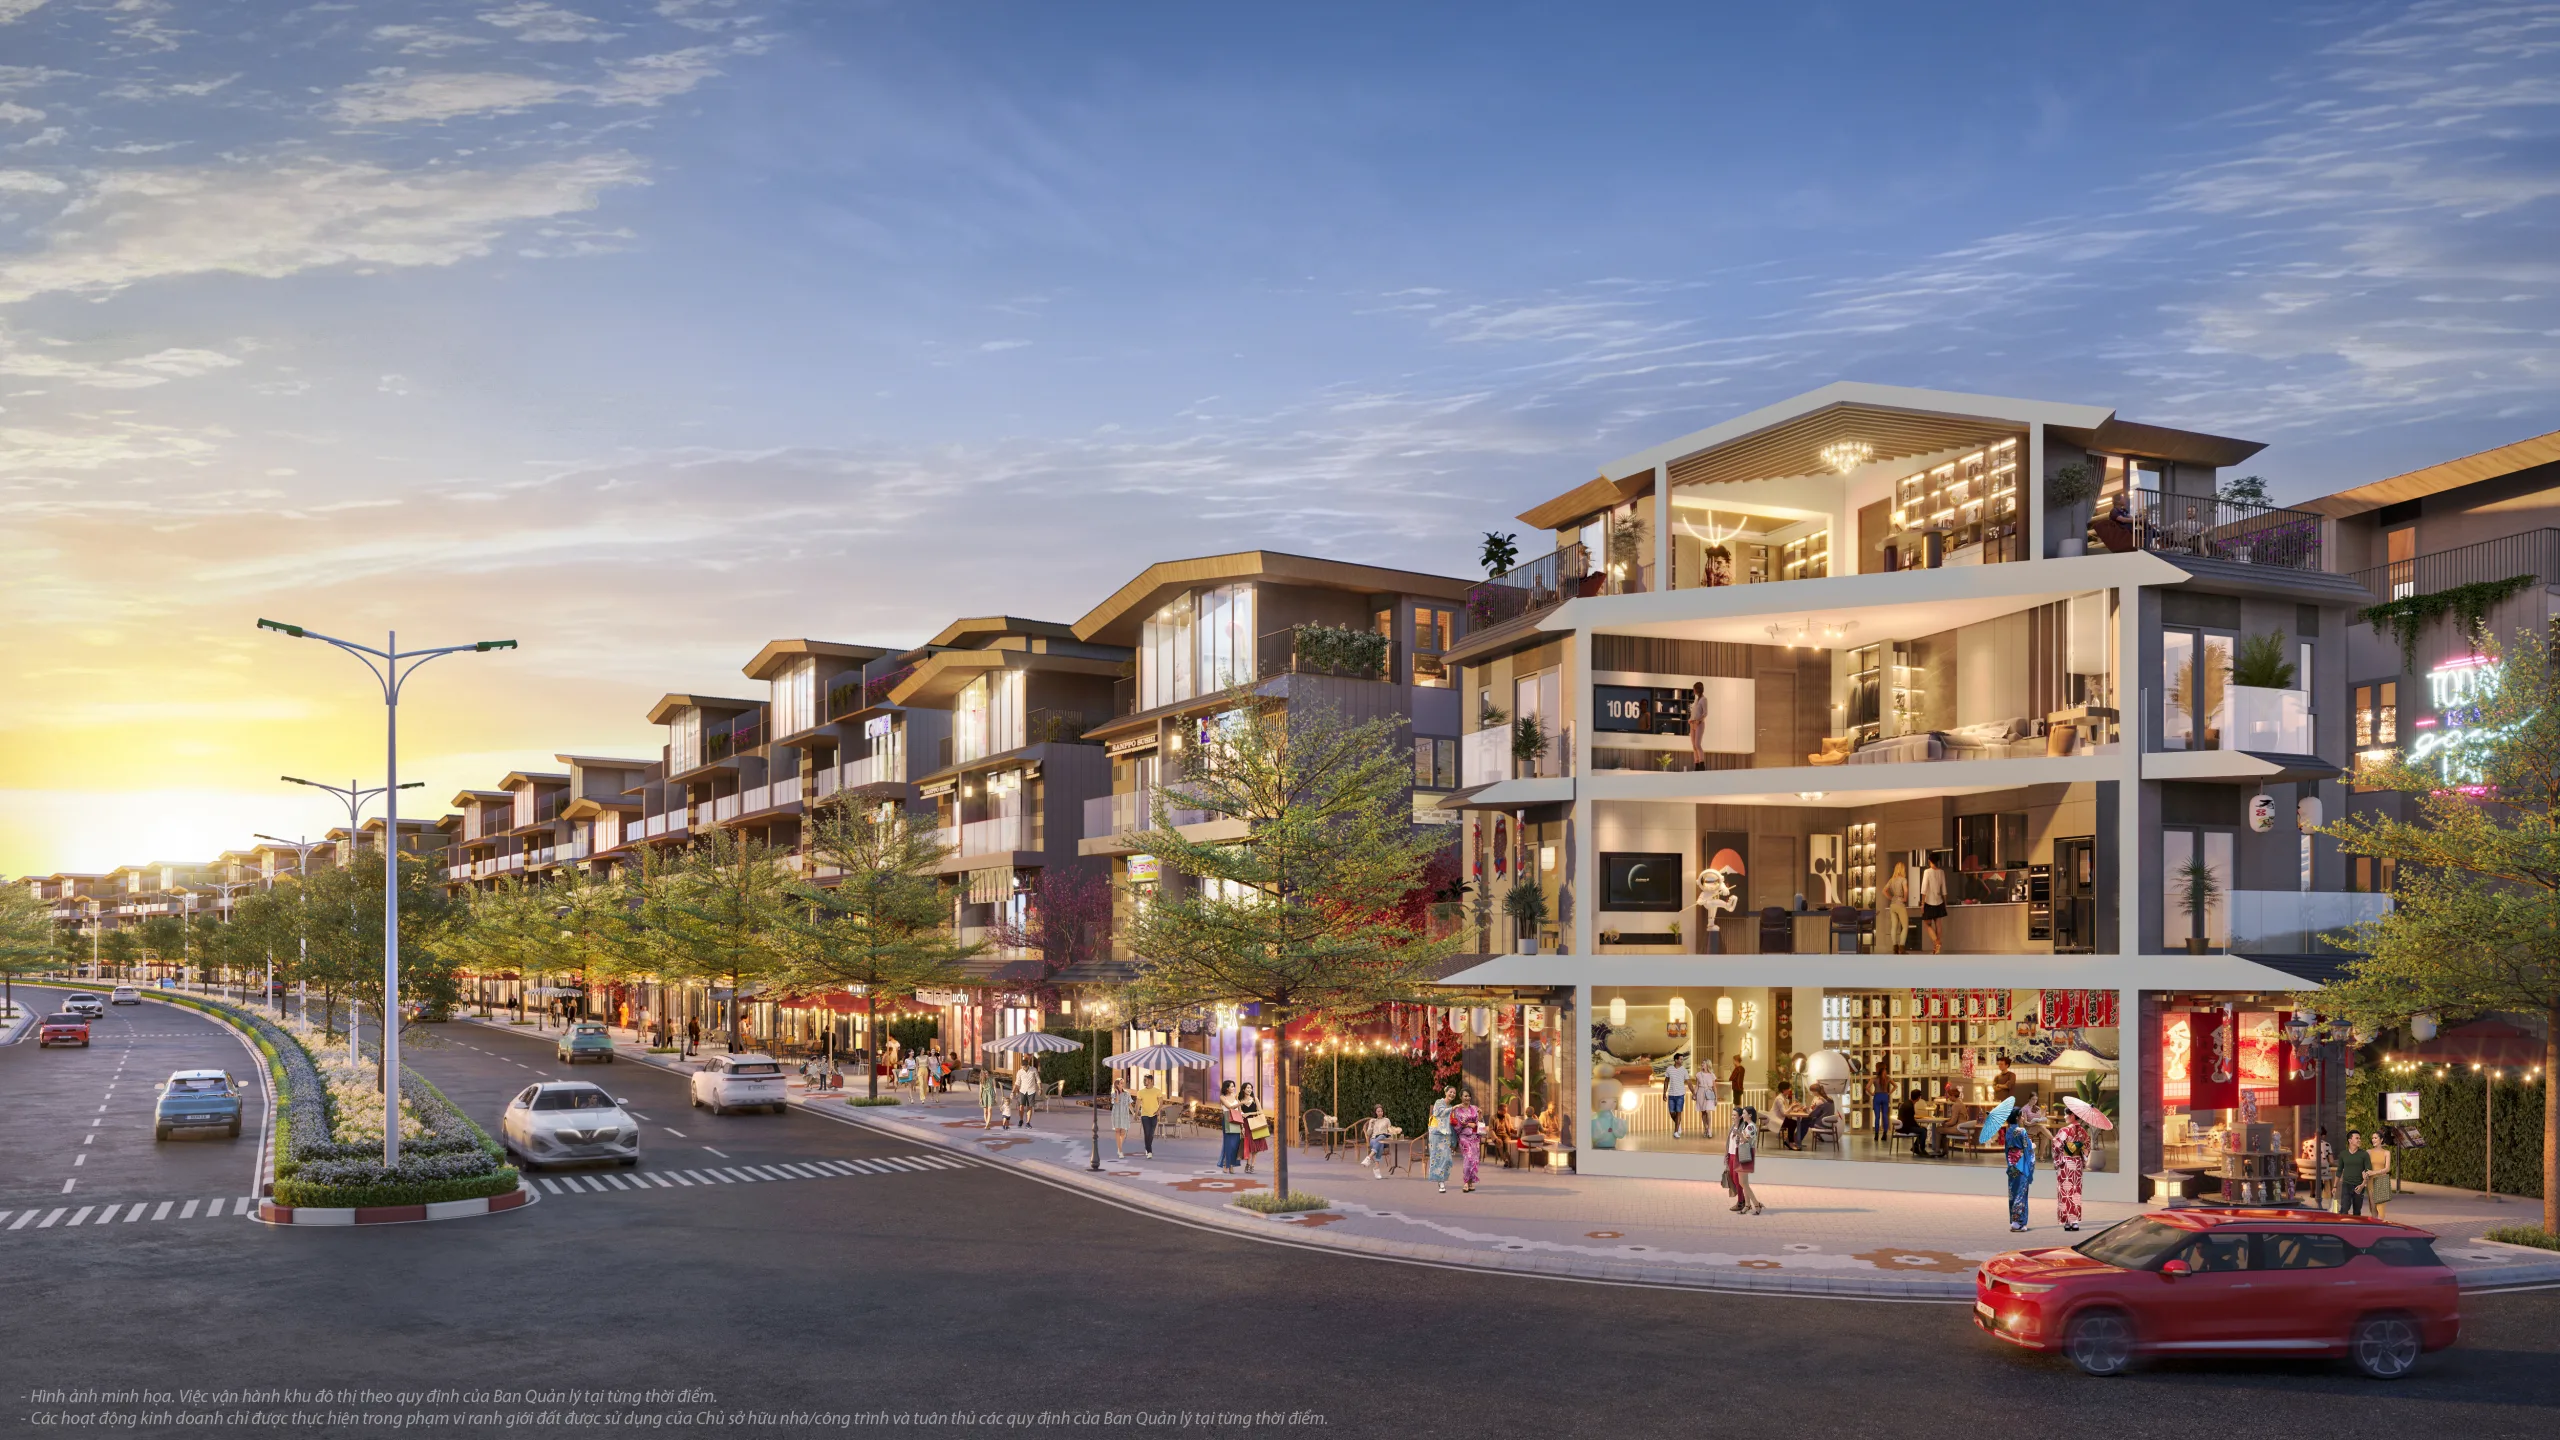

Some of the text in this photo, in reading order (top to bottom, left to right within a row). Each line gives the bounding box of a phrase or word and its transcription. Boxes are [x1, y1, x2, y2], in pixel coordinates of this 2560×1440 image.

[1607, 699, 1640, 719] 10 06
[951, 989, 969, 1006] ucky
